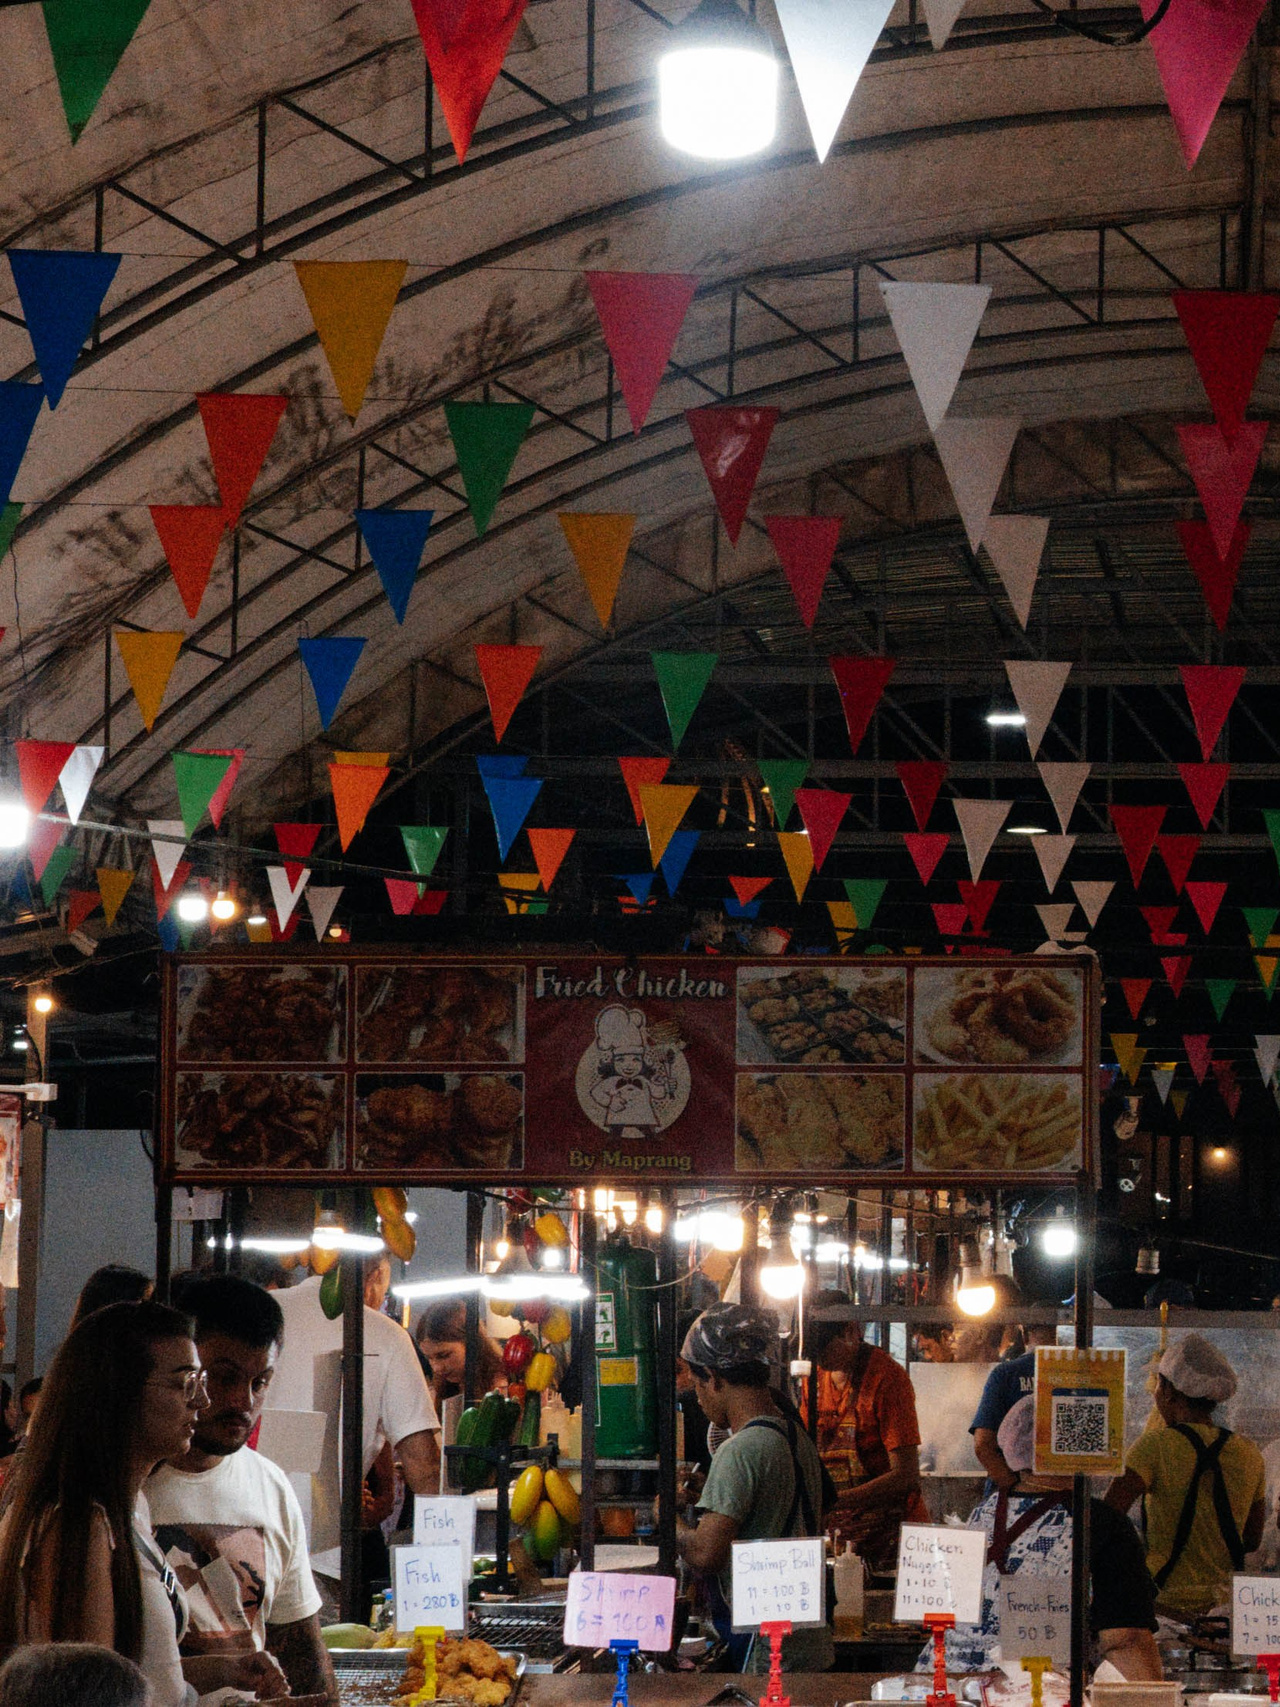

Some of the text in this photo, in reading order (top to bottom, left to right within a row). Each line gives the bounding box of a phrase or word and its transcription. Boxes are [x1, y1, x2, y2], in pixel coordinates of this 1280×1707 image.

[534, 966, 729, 998] Fried Chicken
[569, 1149, 692, 1171] By Maprang
[423, 1508, 455, 1529] Fish
[405, 1559, 441, 1585] Fish
[737, 1548, 815, 1575] Shrimp Ball
